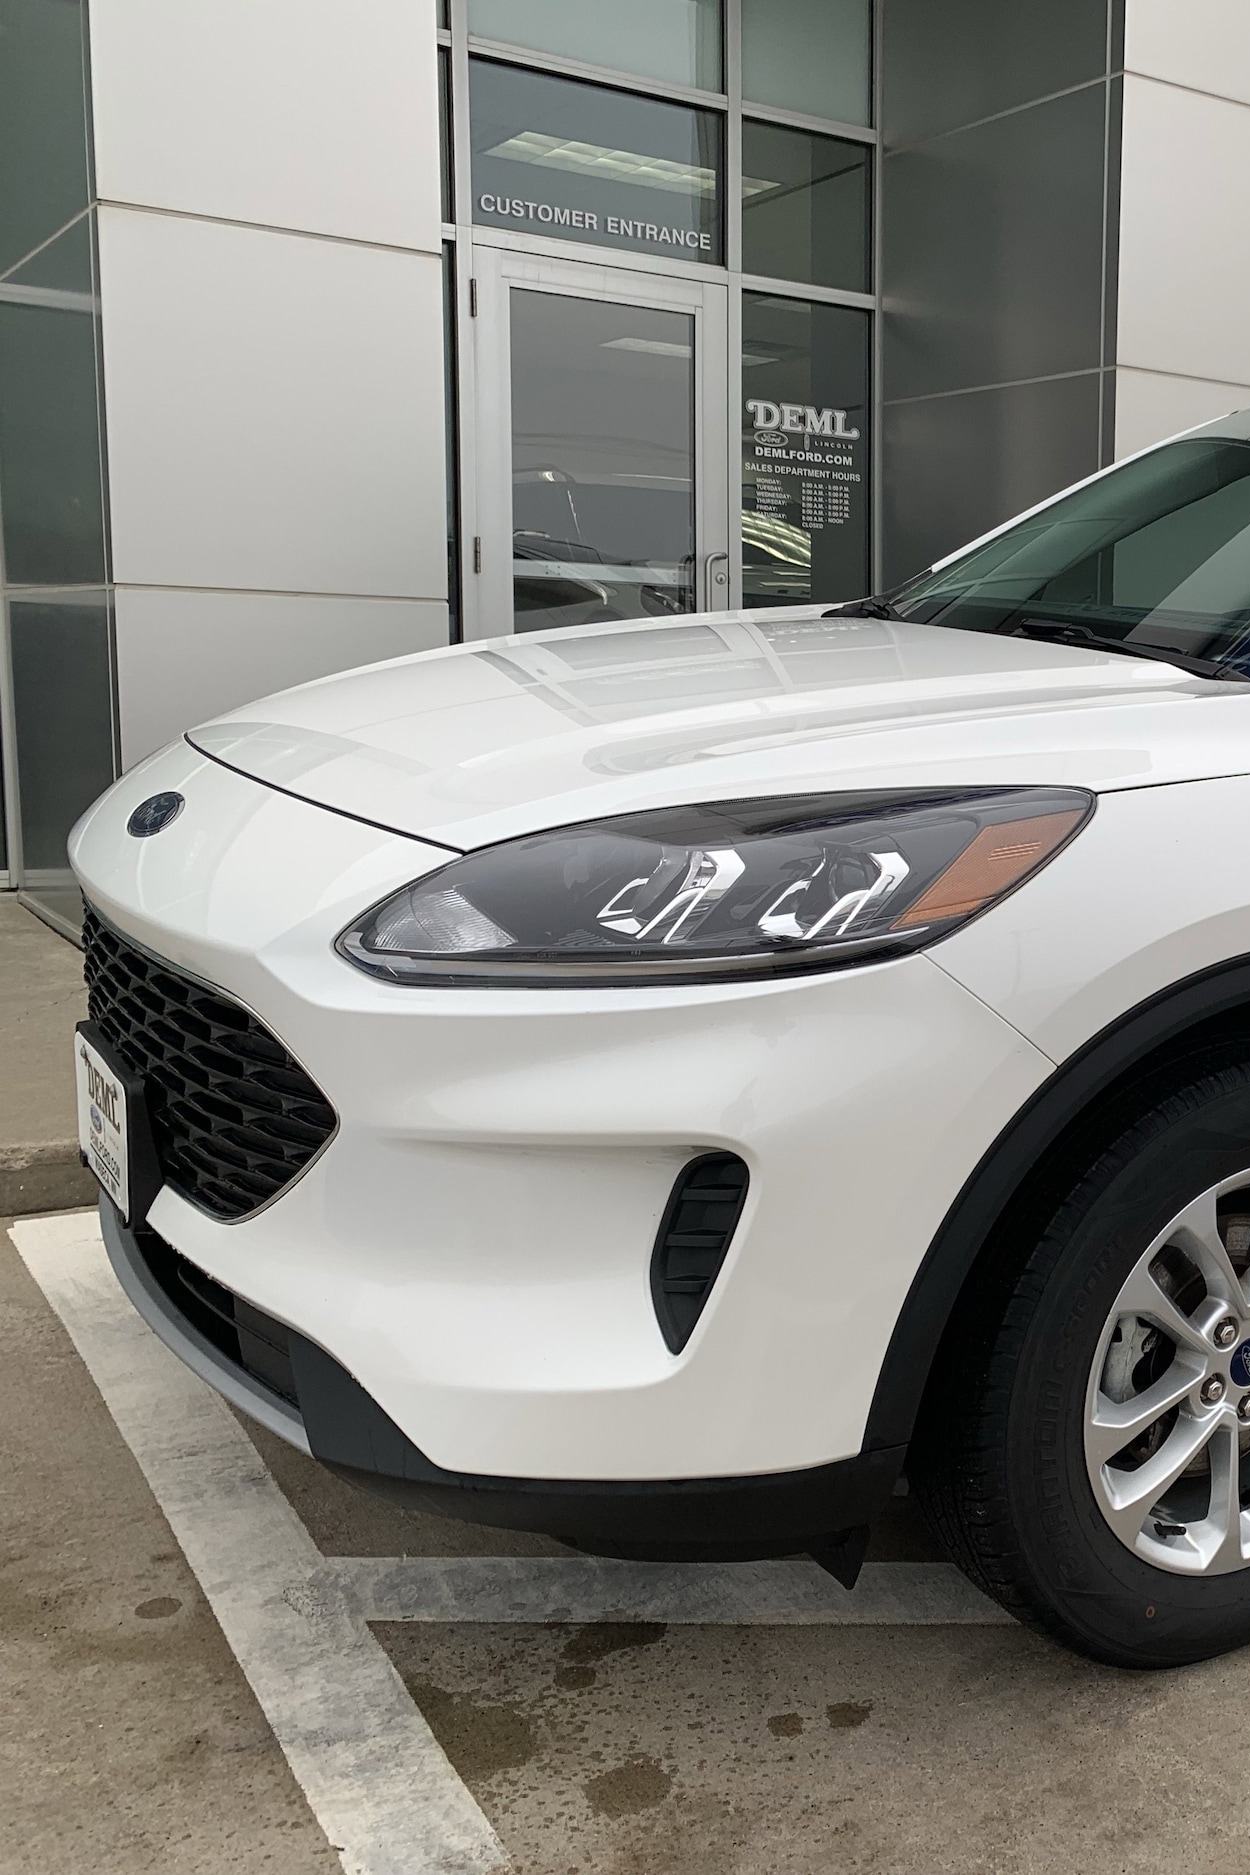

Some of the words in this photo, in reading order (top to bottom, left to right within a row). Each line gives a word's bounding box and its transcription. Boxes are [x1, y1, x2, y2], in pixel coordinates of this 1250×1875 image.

[480, 193, 598, 231] CUSTOMER
[607, 217, 711, 251] ENTRANCE
[746, 399, 860, 440] DEML
[755, 447, 853, 466] DEMLFORD.COM
[814, 440, 853, 450] LINCOLN
[745, 462, 773, 473] SALES
[774, 465, 830, 479] DEPARTMENT
[832, 471, 861, 482] HOURS
[85, 1058, 120, 1134] DEML
